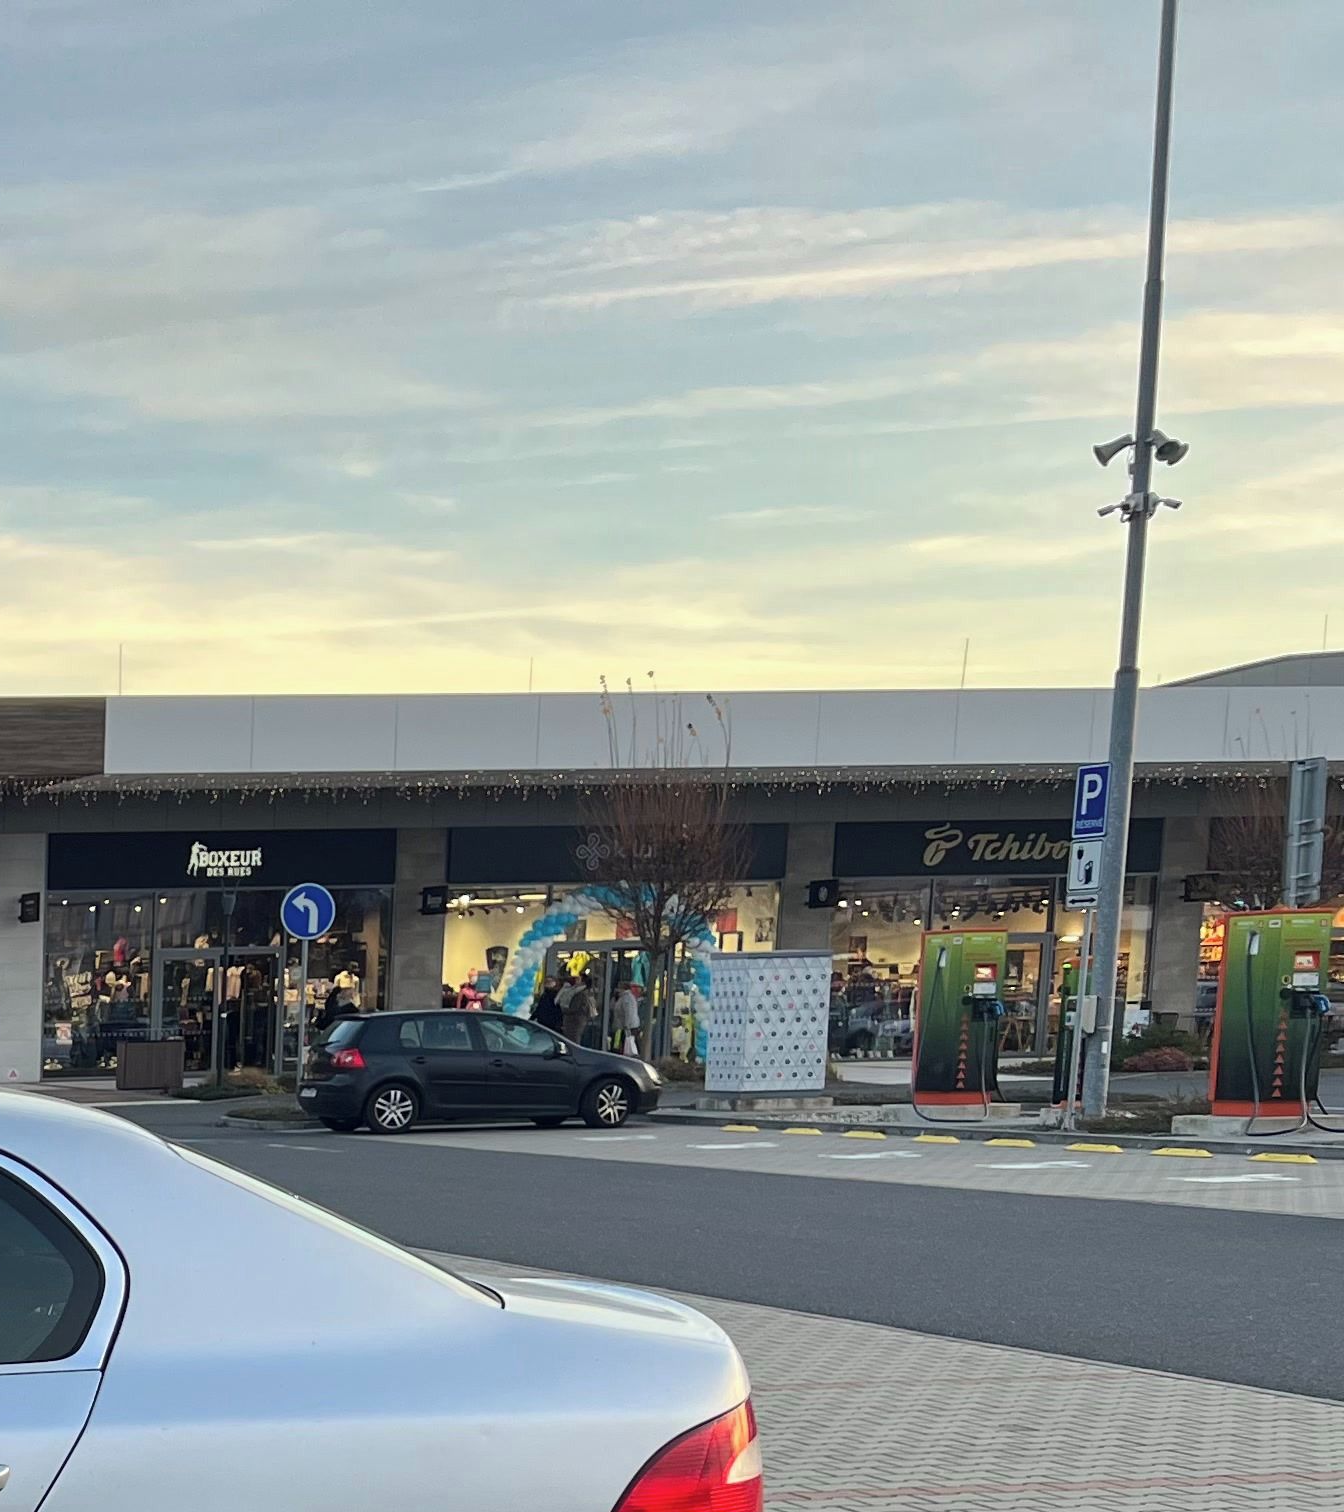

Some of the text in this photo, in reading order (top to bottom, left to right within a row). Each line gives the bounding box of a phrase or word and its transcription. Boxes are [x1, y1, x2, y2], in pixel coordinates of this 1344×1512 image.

[1081, 774, 1103, 815] P
[199, 848, 263, 868] BOXEUR
[967, 832, 1072, 862] Tchibo
[206, 867, 225, 877] DES
